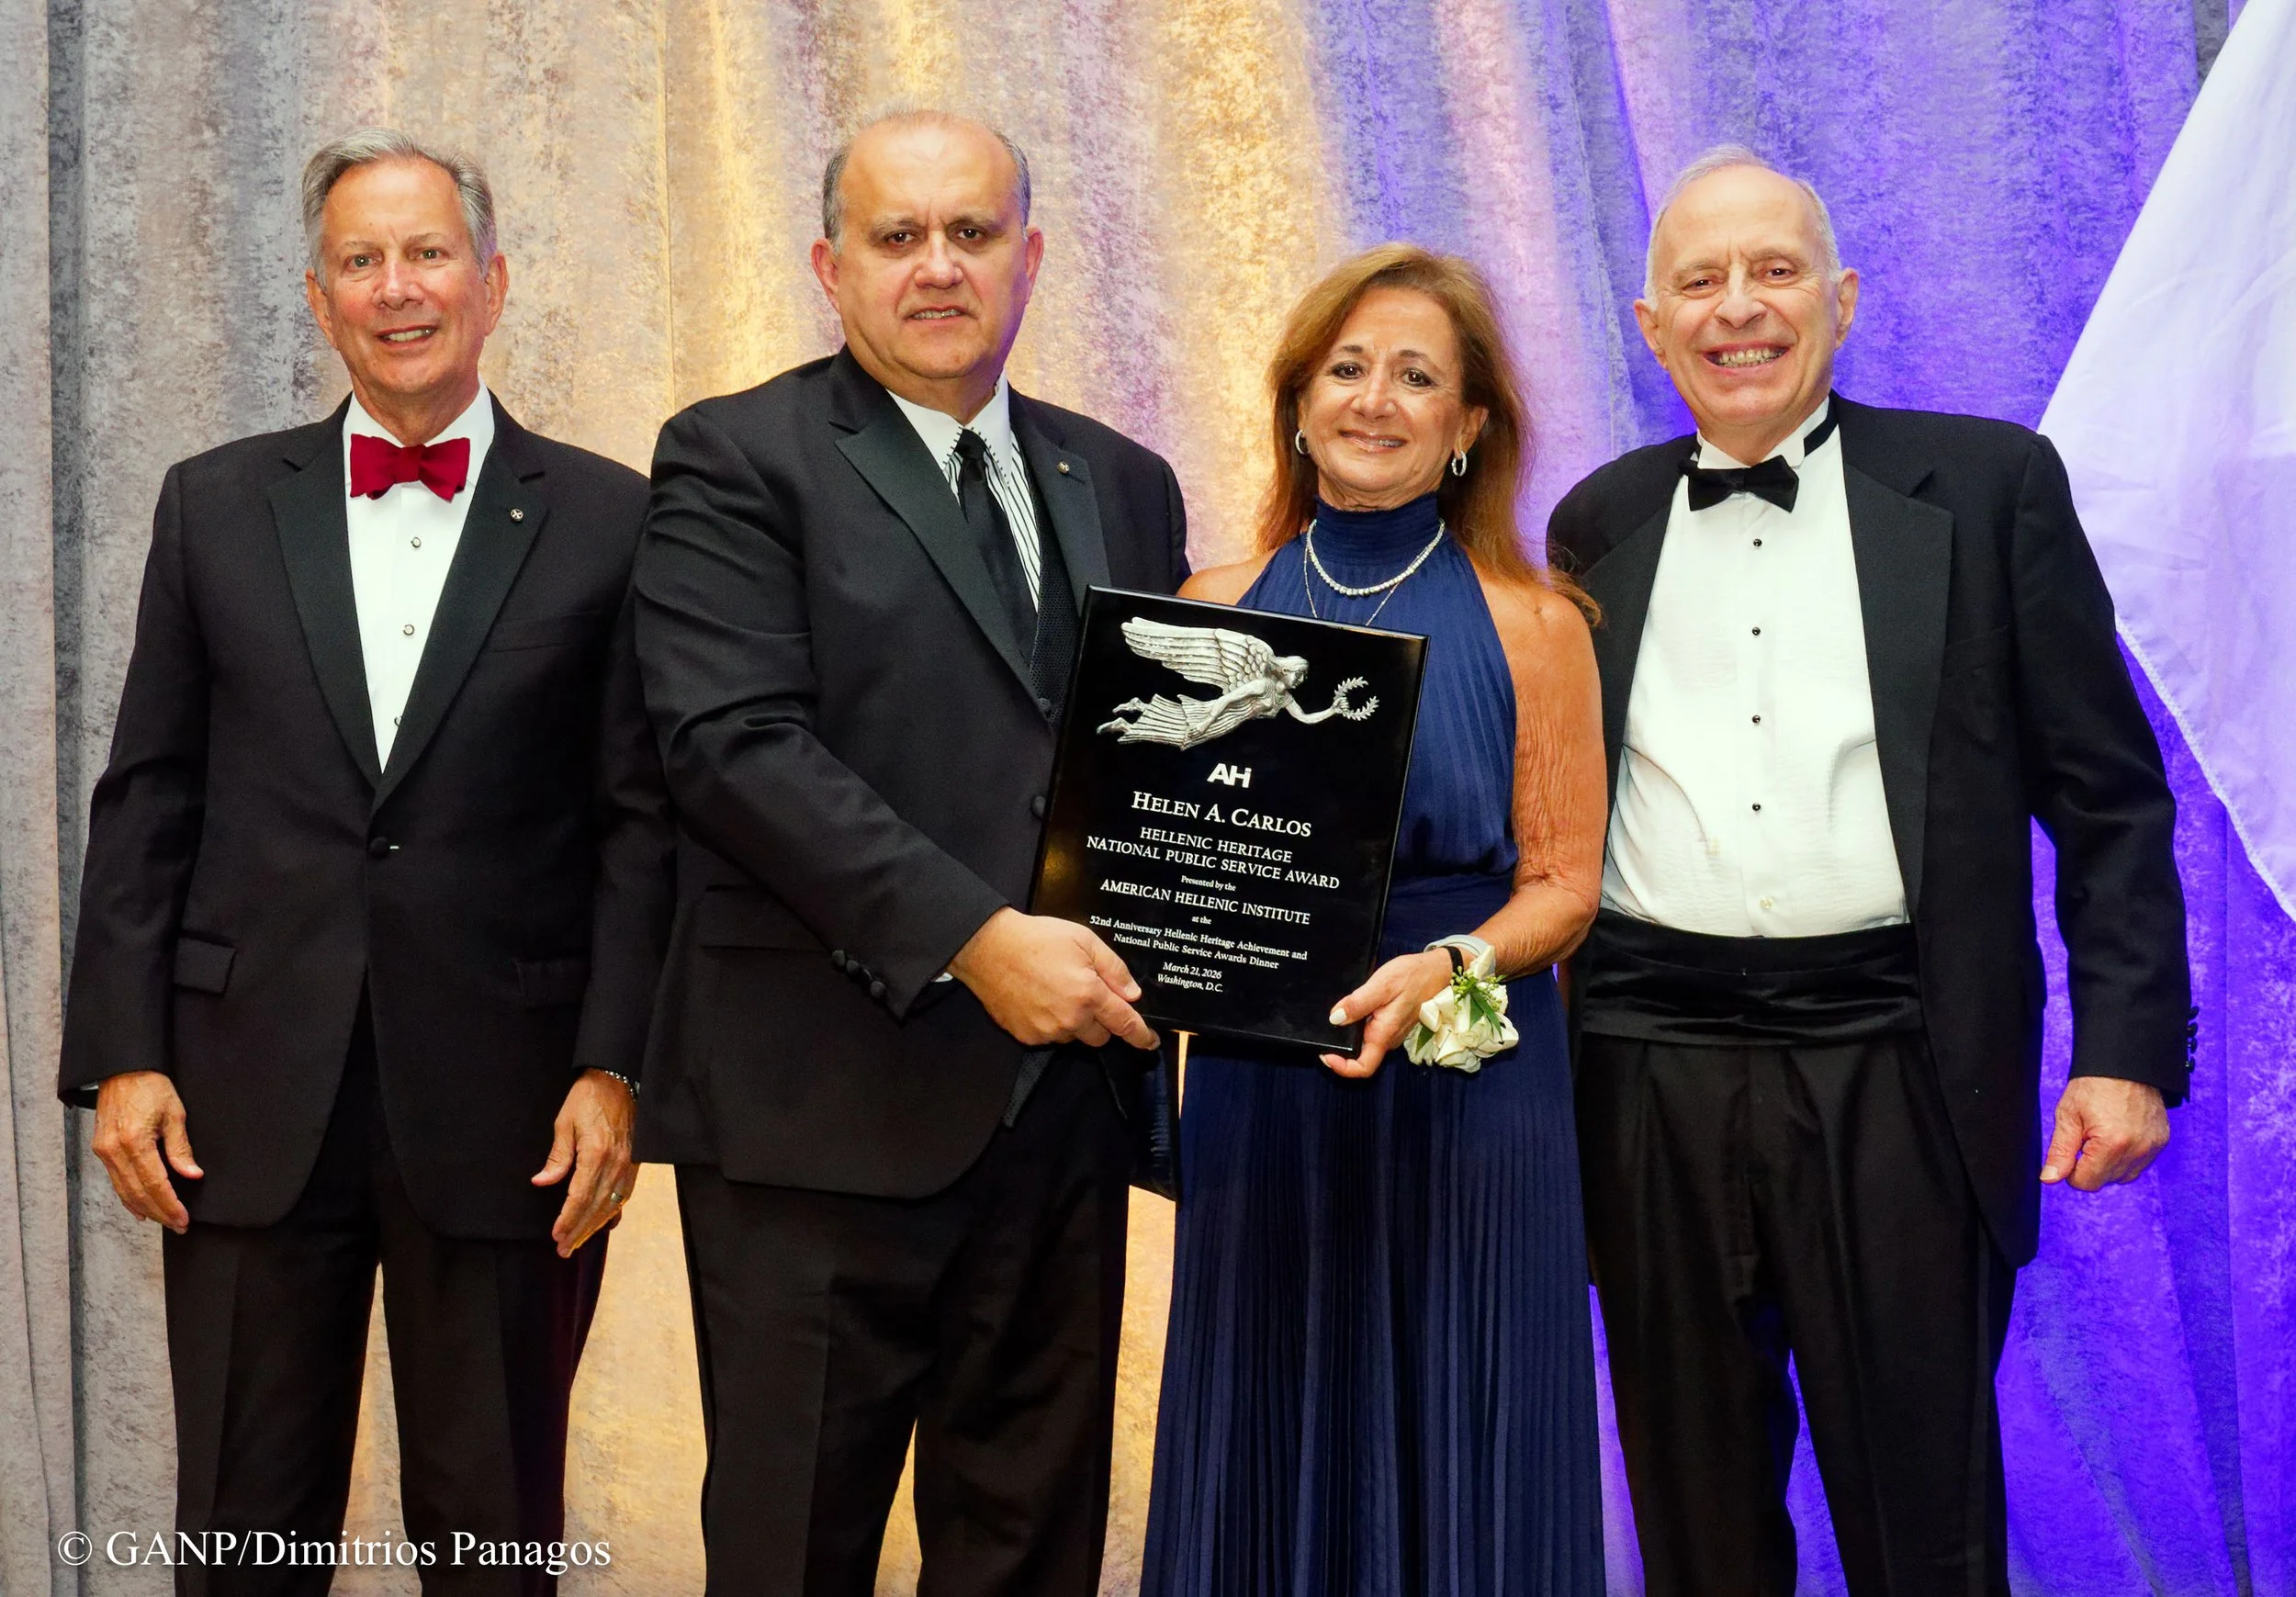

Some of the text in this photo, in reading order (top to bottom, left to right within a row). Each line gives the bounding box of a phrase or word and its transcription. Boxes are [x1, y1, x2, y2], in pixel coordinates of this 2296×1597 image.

[1131, 791, 1311, 837] HELEN A. CARLOS
[1086, 836, 1340, 889] NATIONAL PUBLIC SERVICE AWARD
[1140, 827, 1292, 863] HELLENIC HERITAGE
[1181, 875, 1236, 892] Presented by the
[1100, 879, 1311, 925] AMERICAN HELLENIC INSTITUTE
[1089, 916, 1308, 961] 52nd Anniversary Hellenic Heritage Achievement and
[1192, 916, 1211, 925] at the
[1113, 933, 1279, 969] National Public Service Awards Dinner
[1158, 973, 1222, 993] Washington, D.C.
[1163, 962, 1222, 979] March 21, 2026
